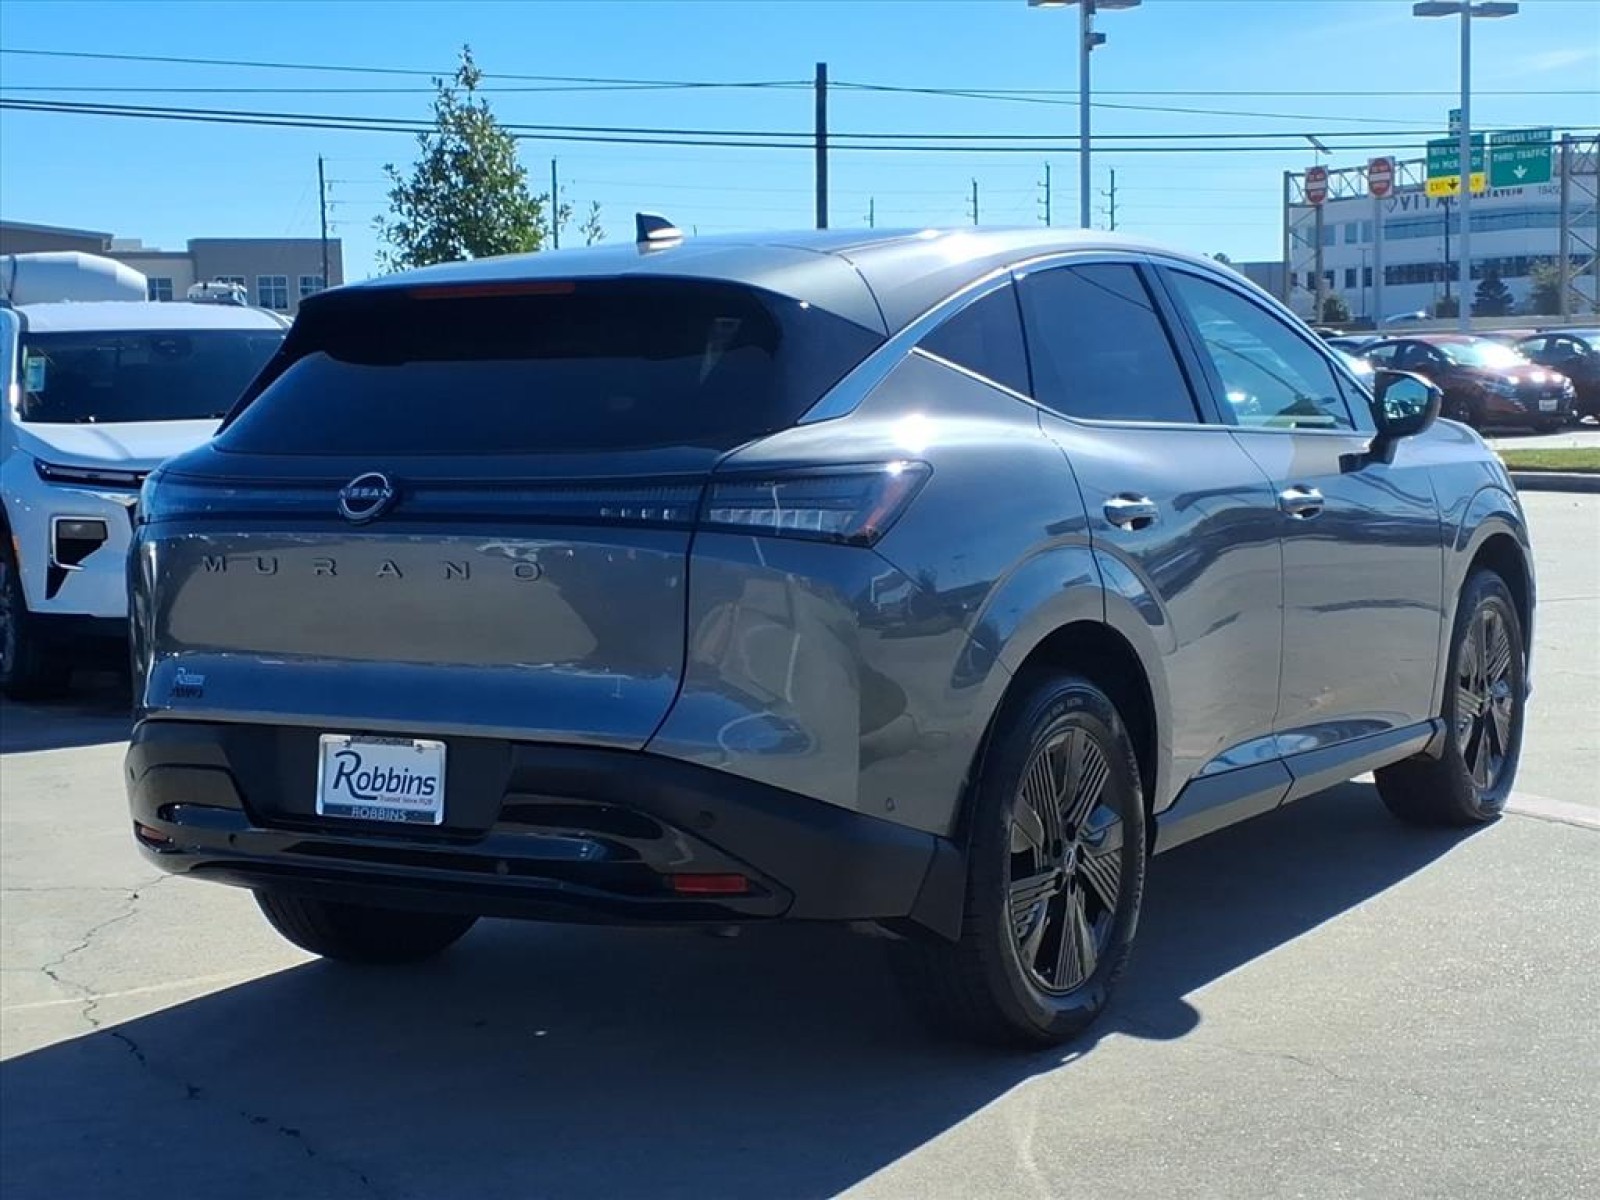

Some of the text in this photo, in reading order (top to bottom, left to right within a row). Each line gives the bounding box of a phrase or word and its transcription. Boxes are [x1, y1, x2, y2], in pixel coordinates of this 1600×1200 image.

[339, 488, 393, 498] NISSAN
[201, 554, 544, 583] MURANO
[332, 750, 436, 801] Robbins
[352, 806, 407, 821] ROBBINS
